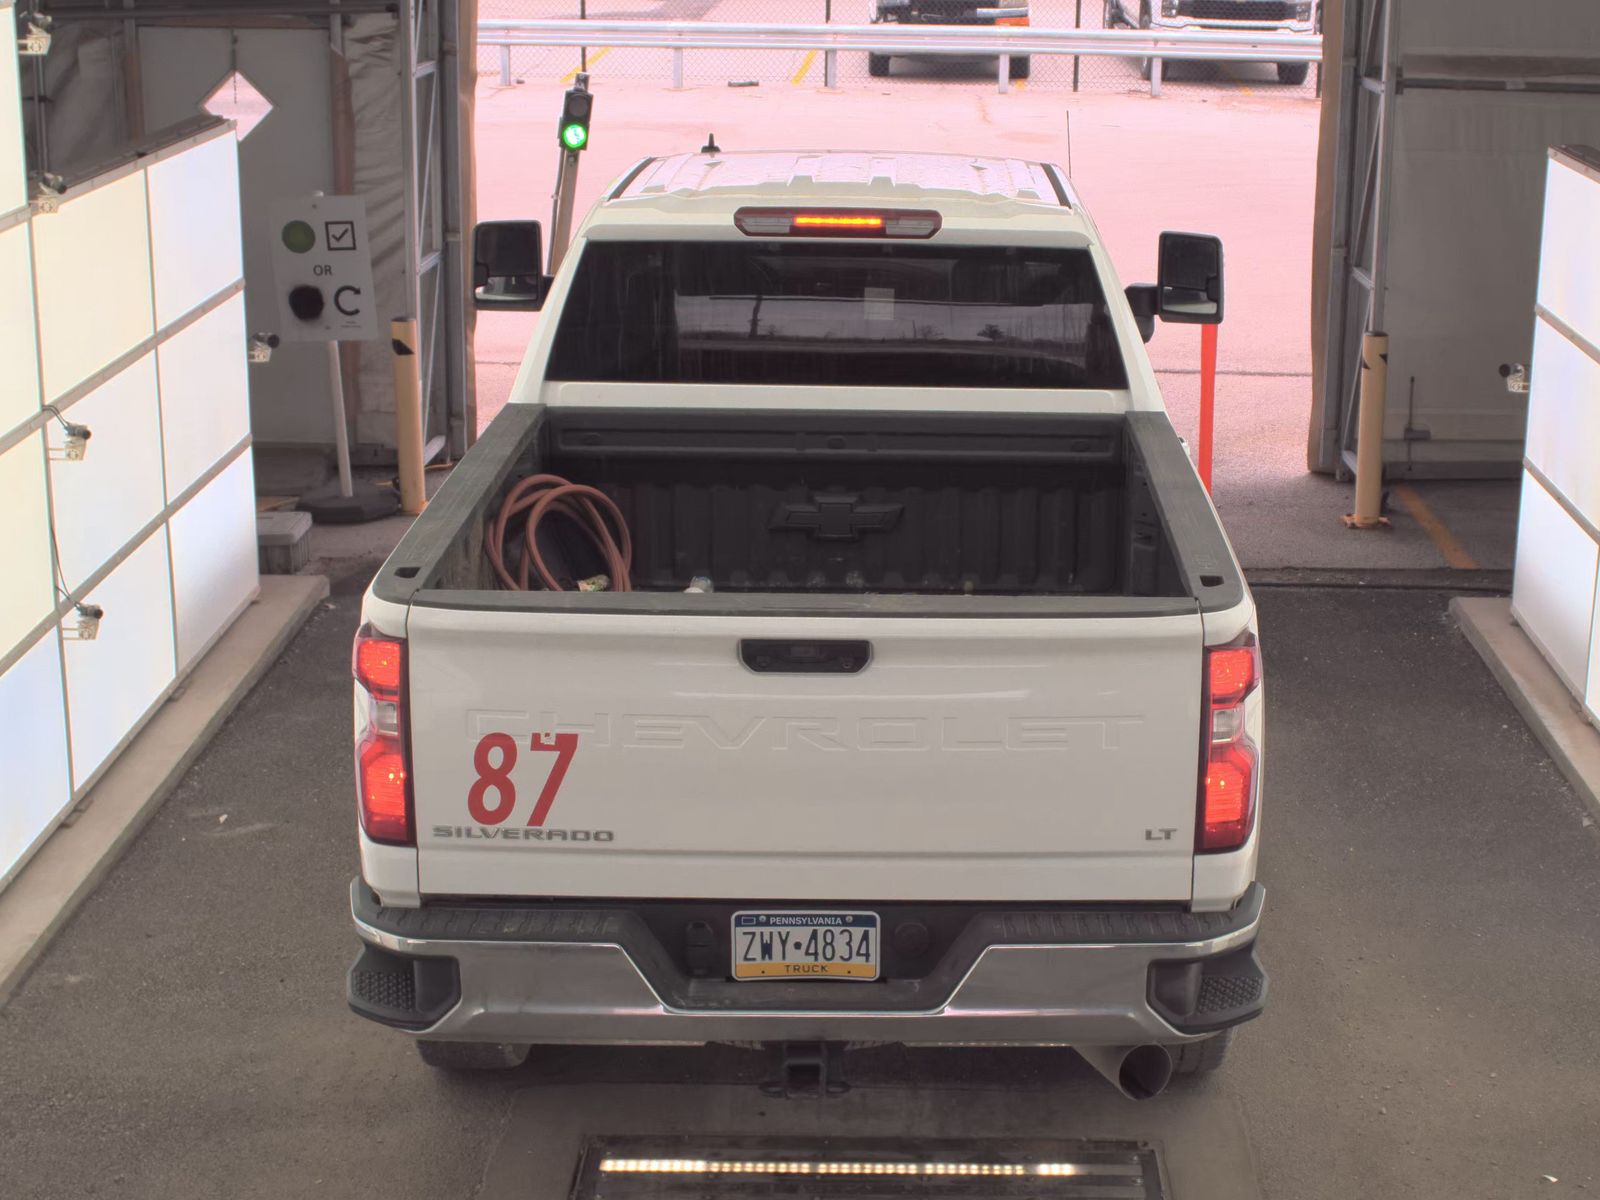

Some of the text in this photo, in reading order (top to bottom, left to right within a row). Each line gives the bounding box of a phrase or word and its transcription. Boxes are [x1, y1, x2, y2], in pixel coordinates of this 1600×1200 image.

[313, 264, 333, 276] OR
[465, 709, 1146, 752] CHEVROLET
[467, 732, 579, 827] 87
[432, 825, 614, 843] SILVERADO
[1145, 828, 1178, 841] LT
[769, 916, 843, 925] PENNSYLVANIA
[784, 964, 829, 973] TRUCK
